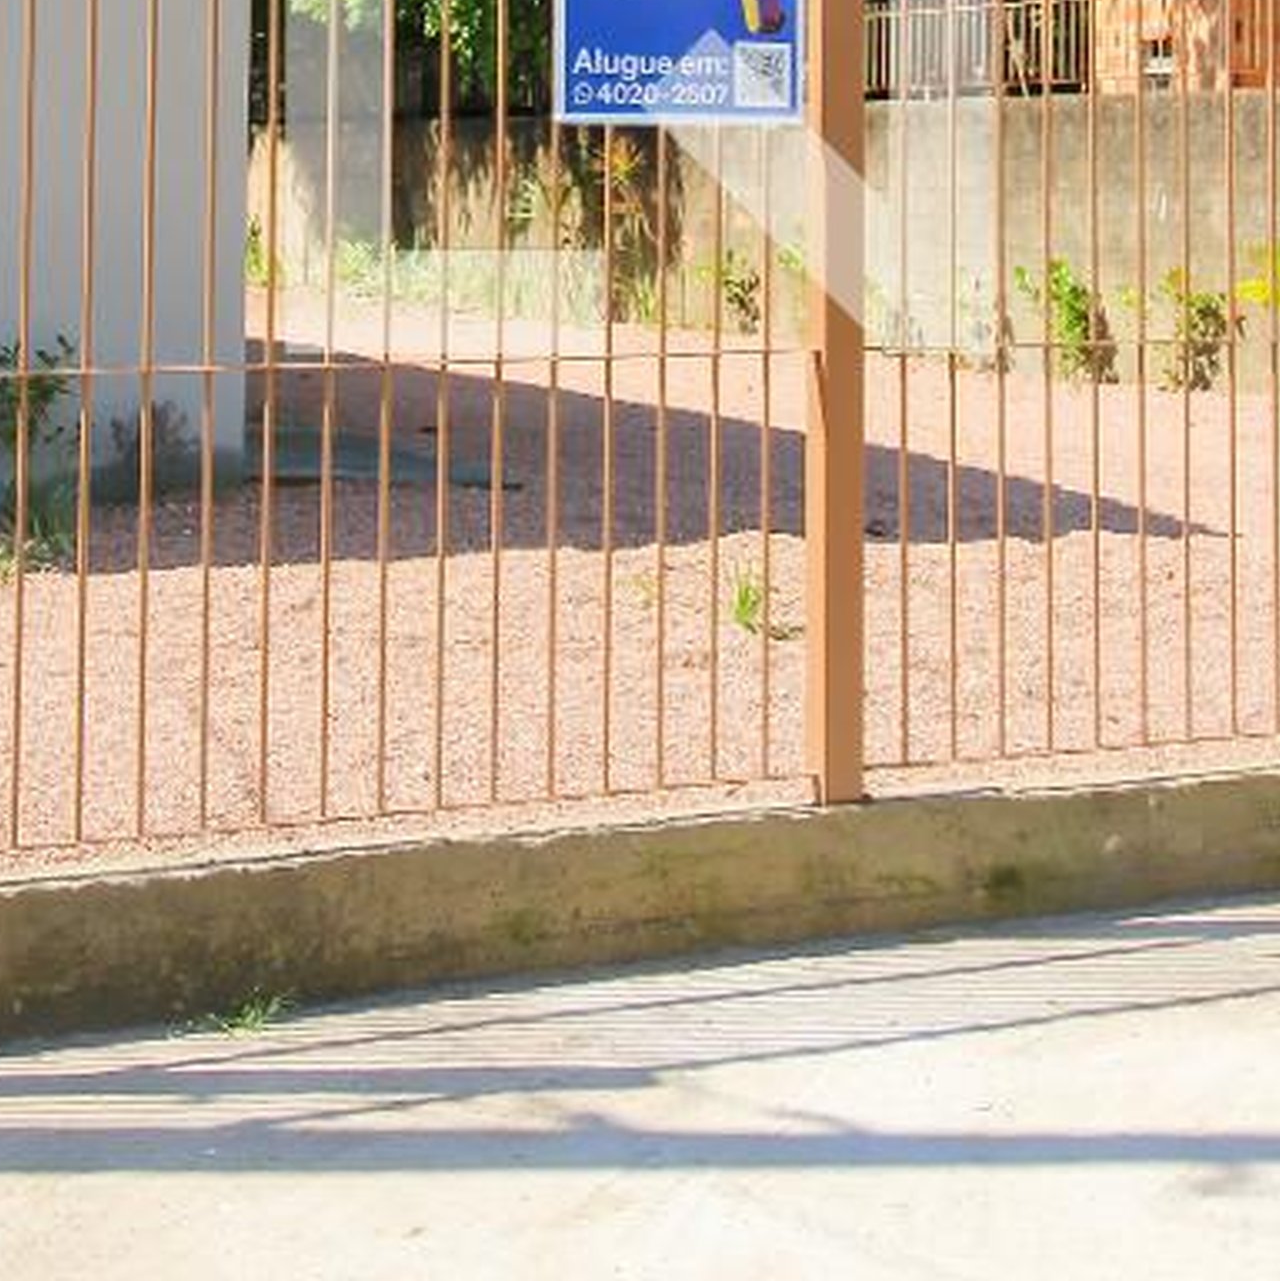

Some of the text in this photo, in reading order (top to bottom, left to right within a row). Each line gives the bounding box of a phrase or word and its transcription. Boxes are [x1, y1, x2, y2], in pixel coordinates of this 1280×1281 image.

[572, 48, 730, 82] Alugue em:
[596, 82, 729, 105] 4020-2507
